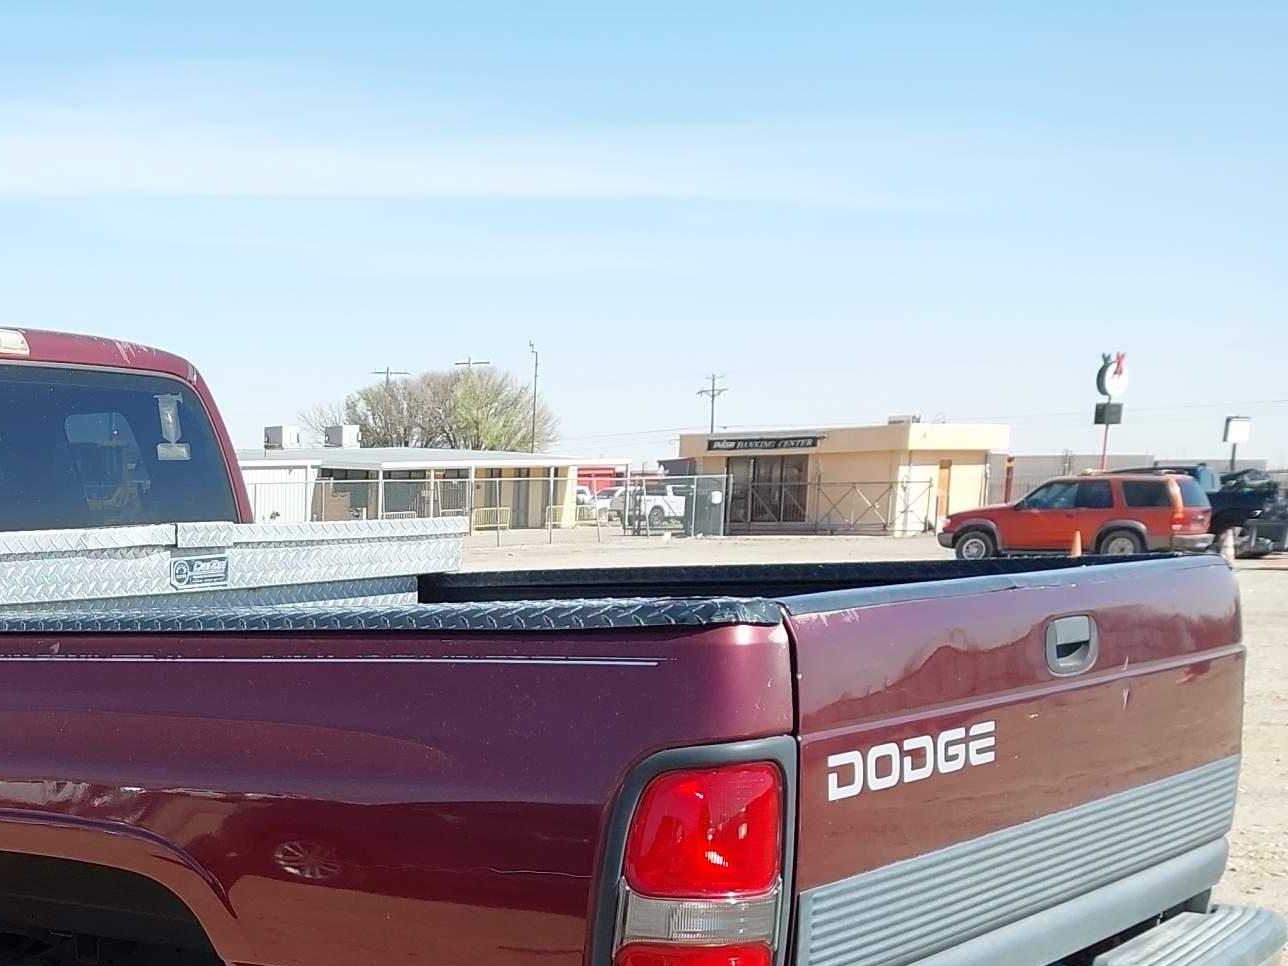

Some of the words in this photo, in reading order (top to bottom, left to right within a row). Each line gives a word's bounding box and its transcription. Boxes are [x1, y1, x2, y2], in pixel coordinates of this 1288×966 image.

[736, 439, 776, 449] BANKING
[778, 438, 813, 448] CENTER
[828, 721, 996, 801] DODGE
